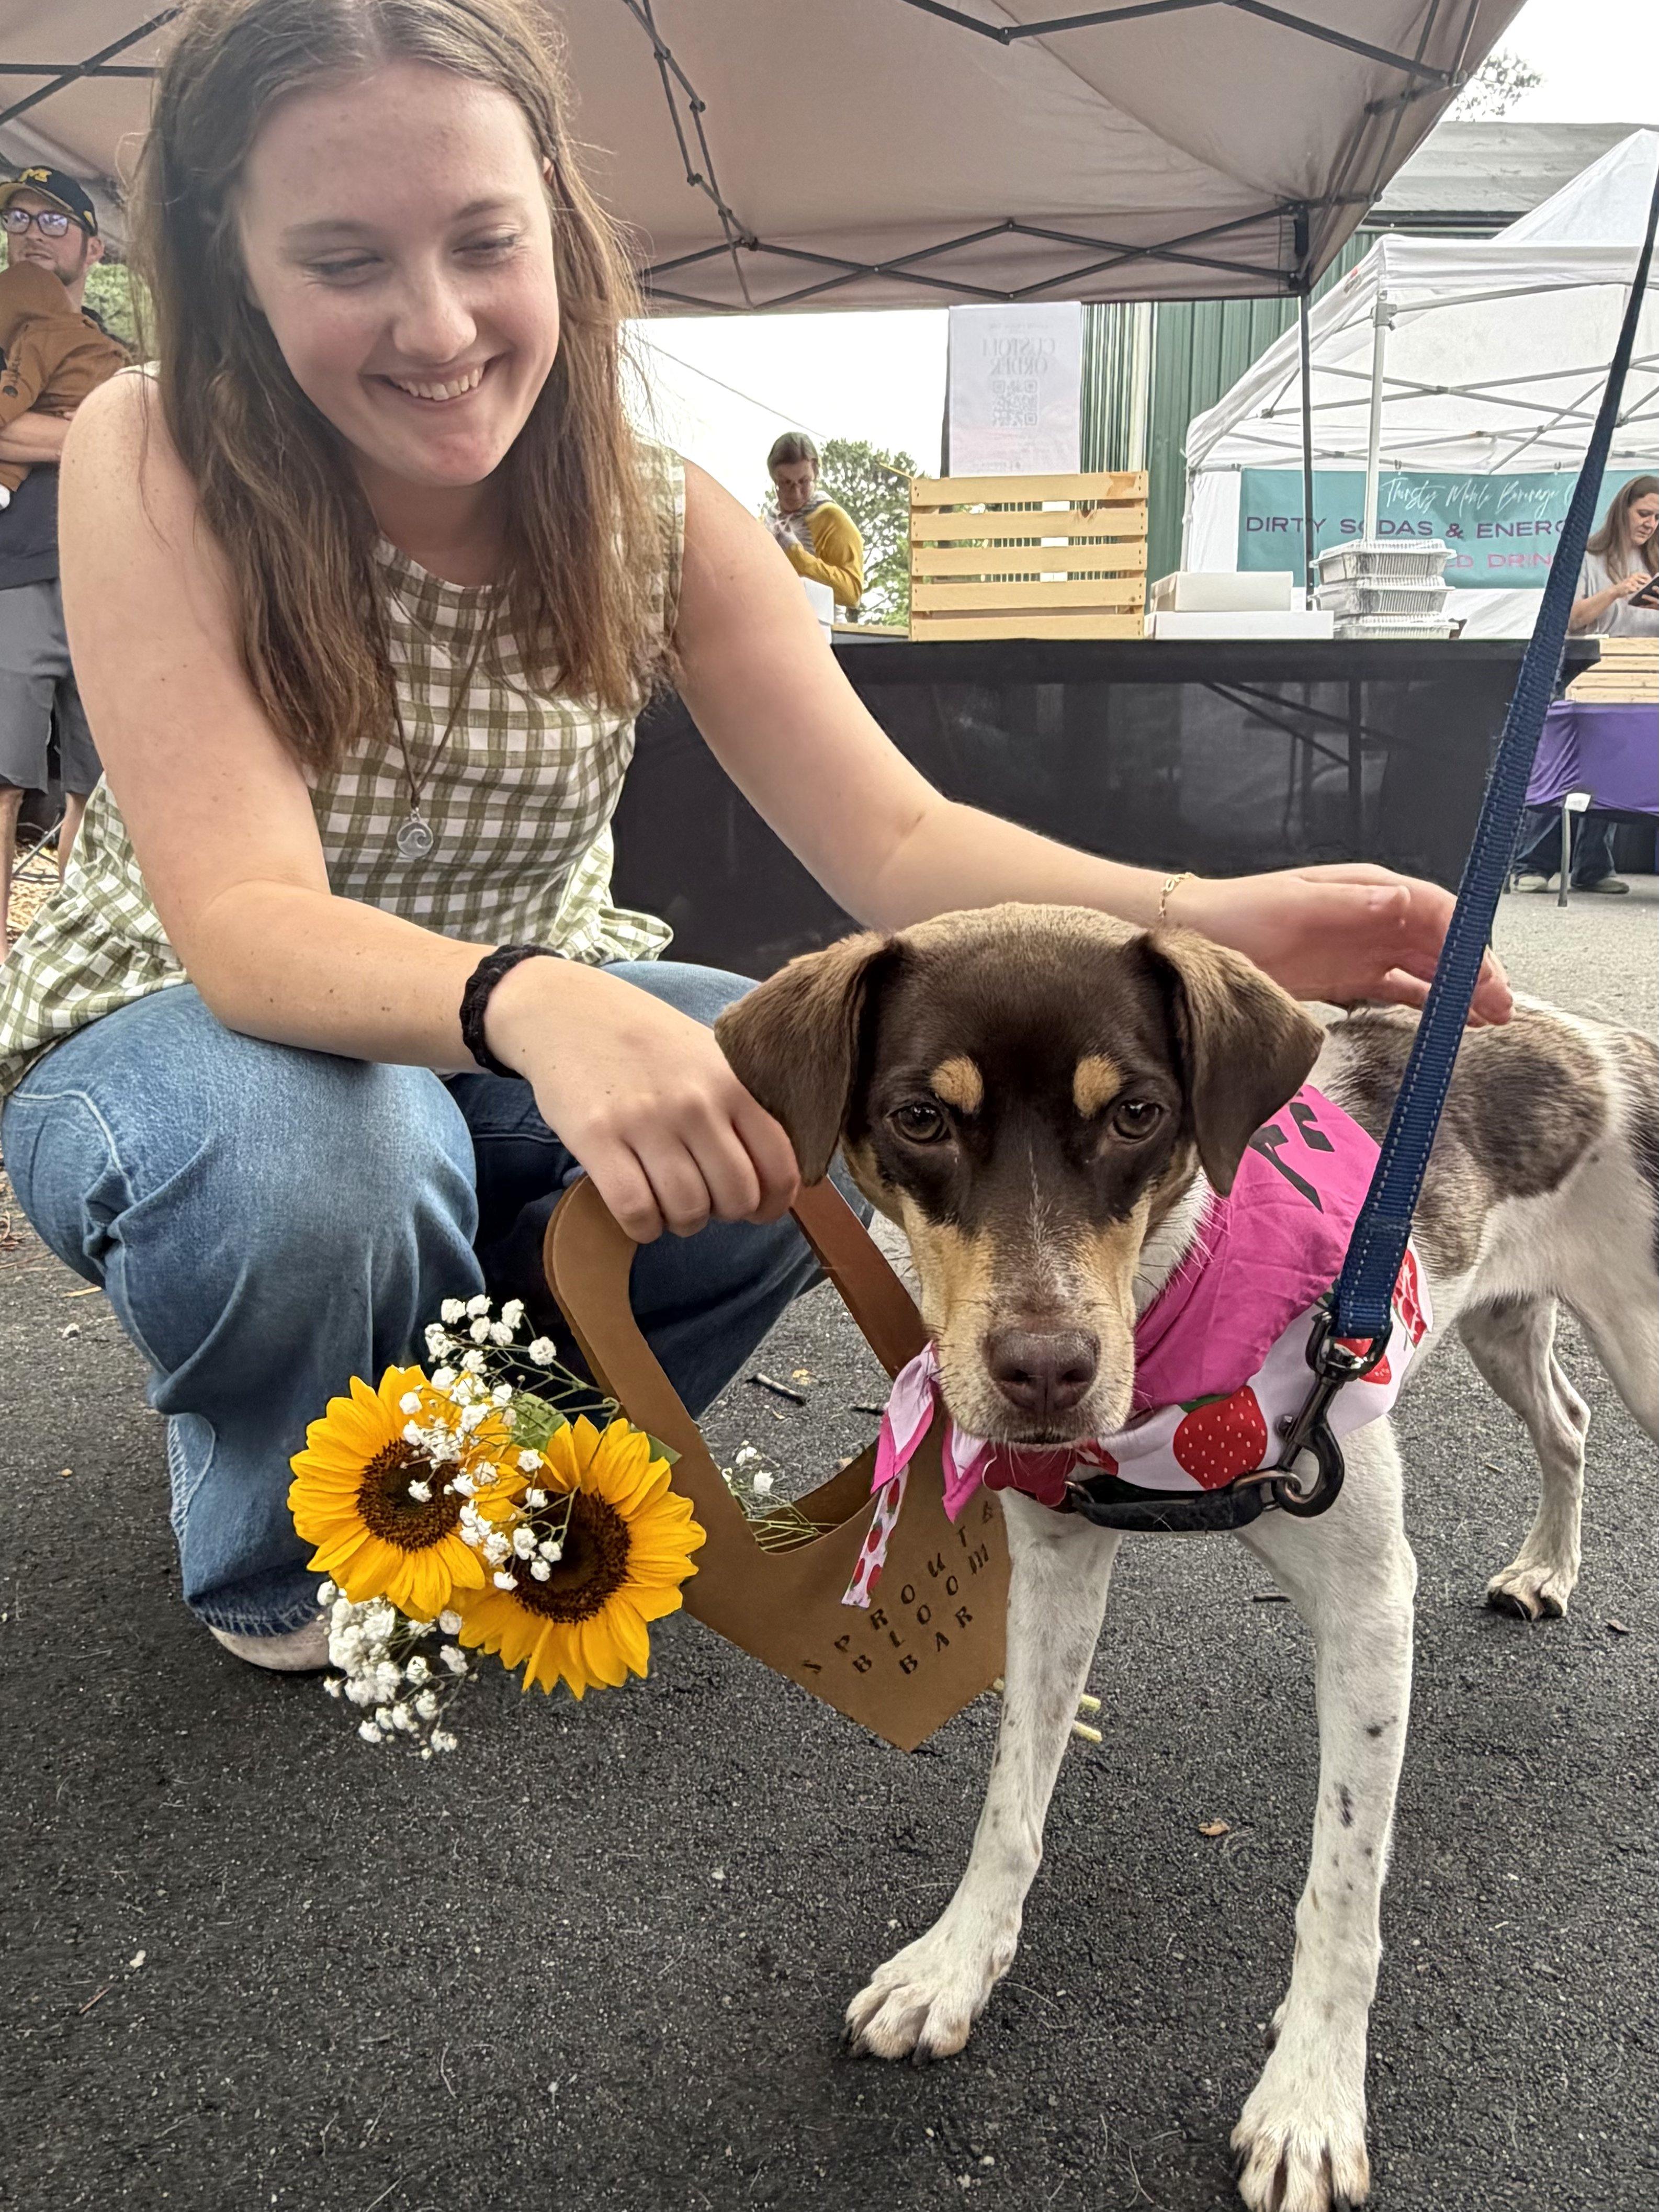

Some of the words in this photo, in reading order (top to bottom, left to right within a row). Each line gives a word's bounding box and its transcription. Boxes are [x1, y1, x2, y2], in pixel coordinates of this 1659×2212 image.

[1246, 516, 1327, 533] DIRTY
[1445, 523, 1464, 539] &
[1476, 520, 1565, 538] ENER
[1487, 552, 1553, 568] DRIN
[853, 1543, 990, 1673] BLOOM
[899, 1605, 973, 1674] BAR
